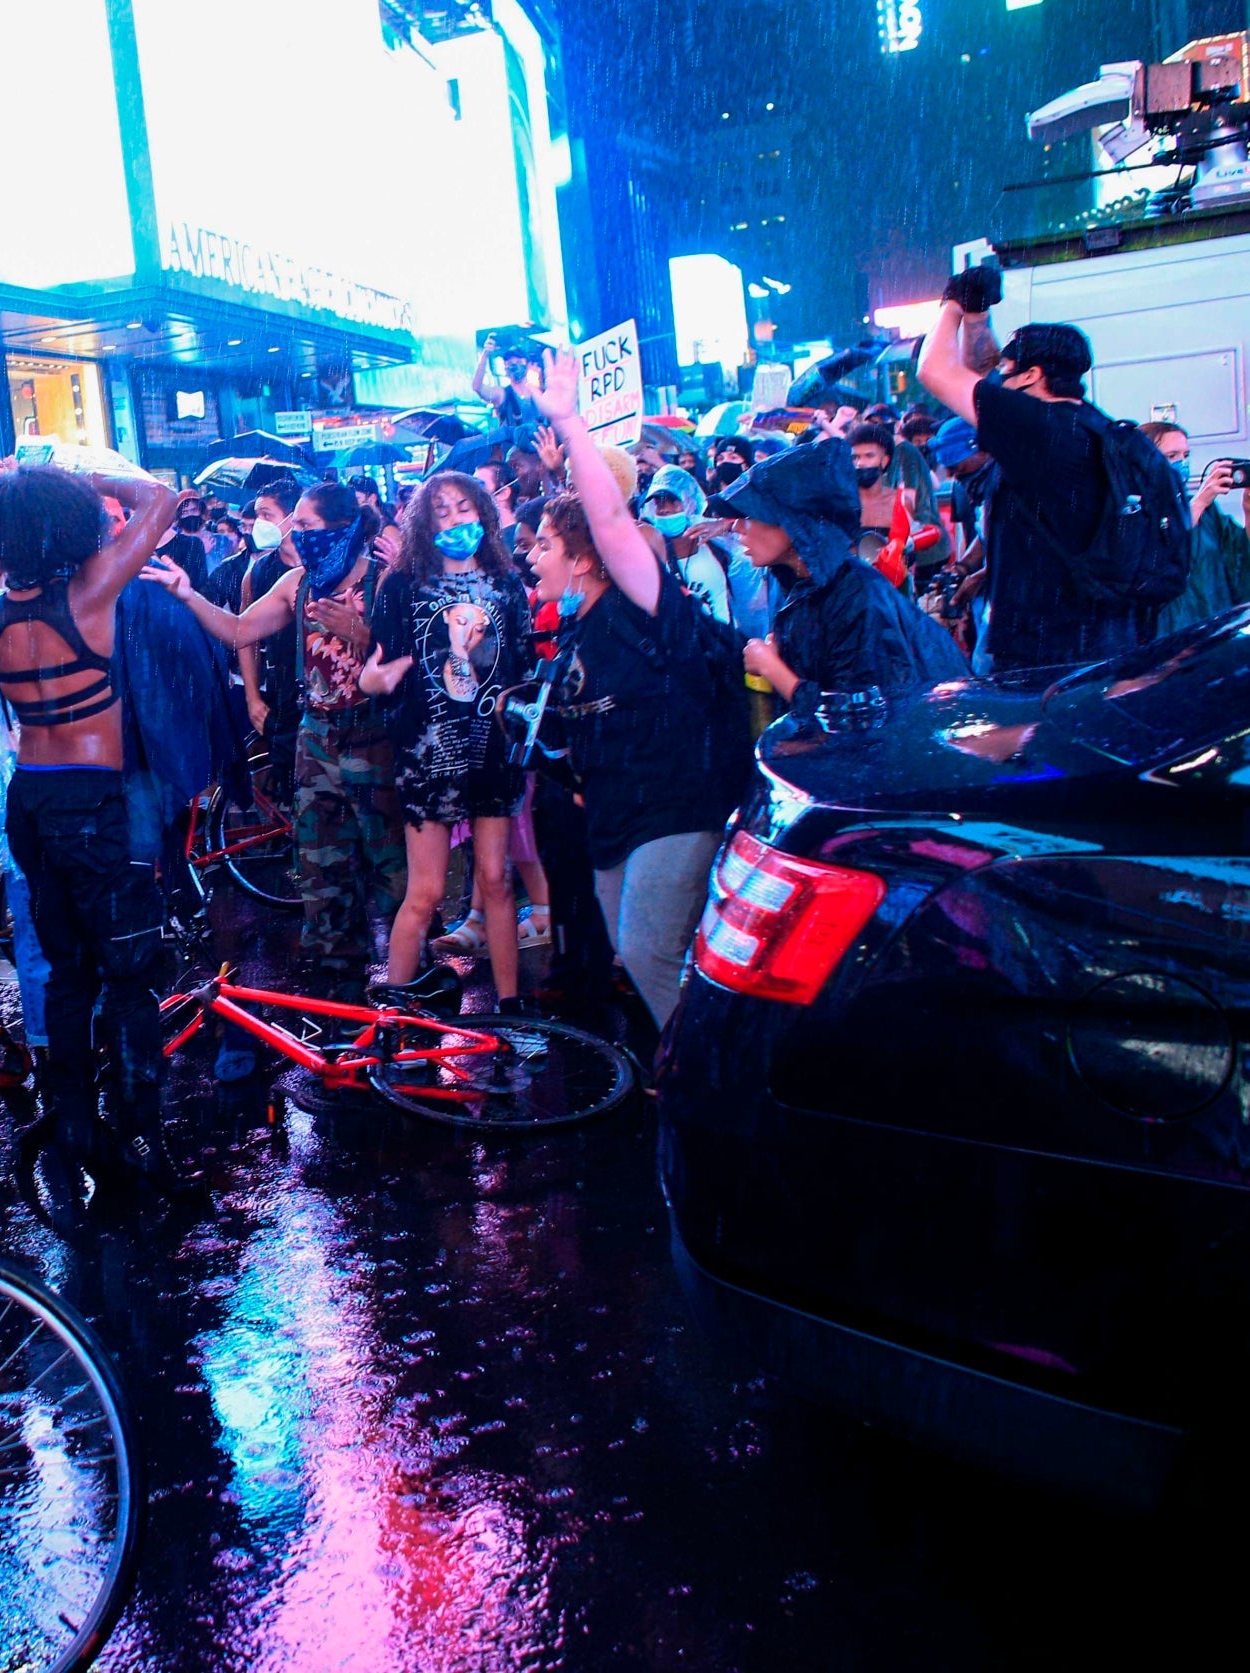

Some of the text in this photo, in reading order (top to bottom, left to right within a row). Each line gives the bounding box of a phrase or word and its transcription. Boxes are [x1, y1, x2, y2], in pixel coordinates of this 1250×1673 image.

[161, 222, 280, 298] AMERICAN
[582, 335, 632, 378] FUCK
[591, 366, 626, 402] RPD
[584, 389, 641, 429] DISARM
[428, 594, 454, 612] One
[477, 684, 502, 717] 6
